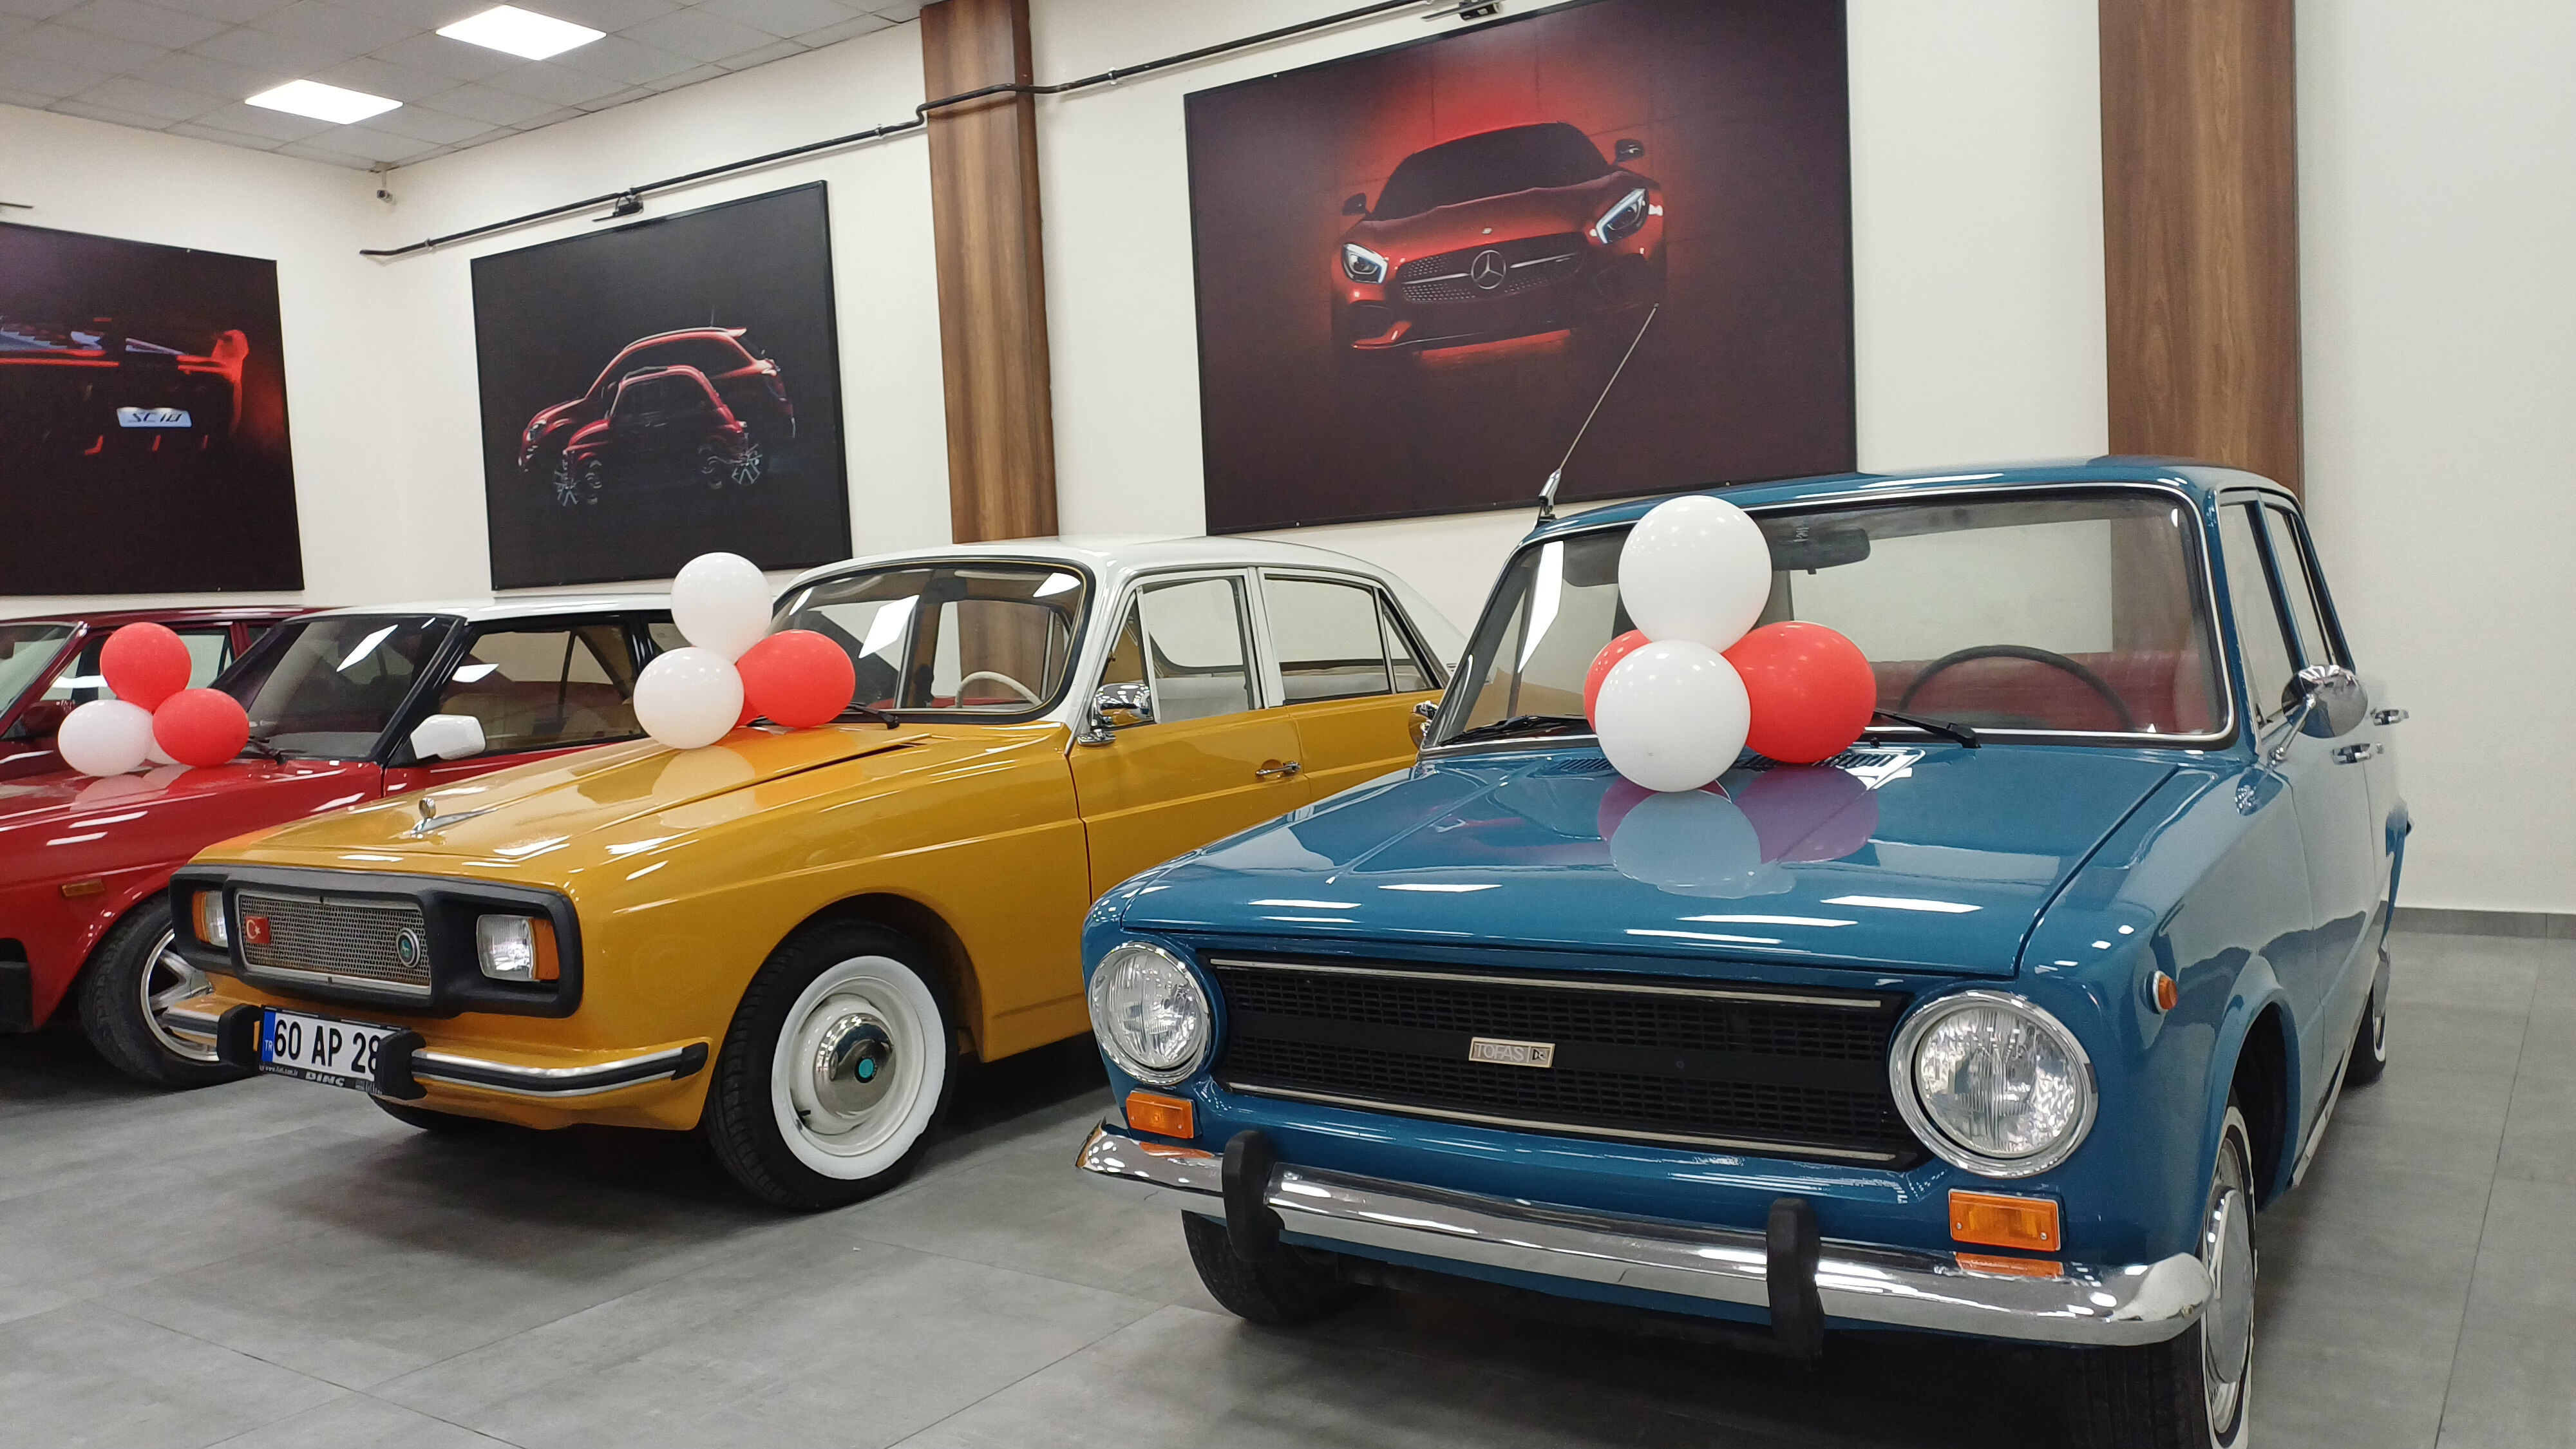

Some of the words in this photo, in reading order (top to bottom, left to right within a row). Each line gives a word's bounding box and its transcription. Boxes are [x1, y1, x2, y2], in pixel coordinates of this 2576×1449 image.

[265, 1039, 273, 1051] TR
[274, 1019, 301, 1060] 60
[311, 1025, 343, 1067] AP
